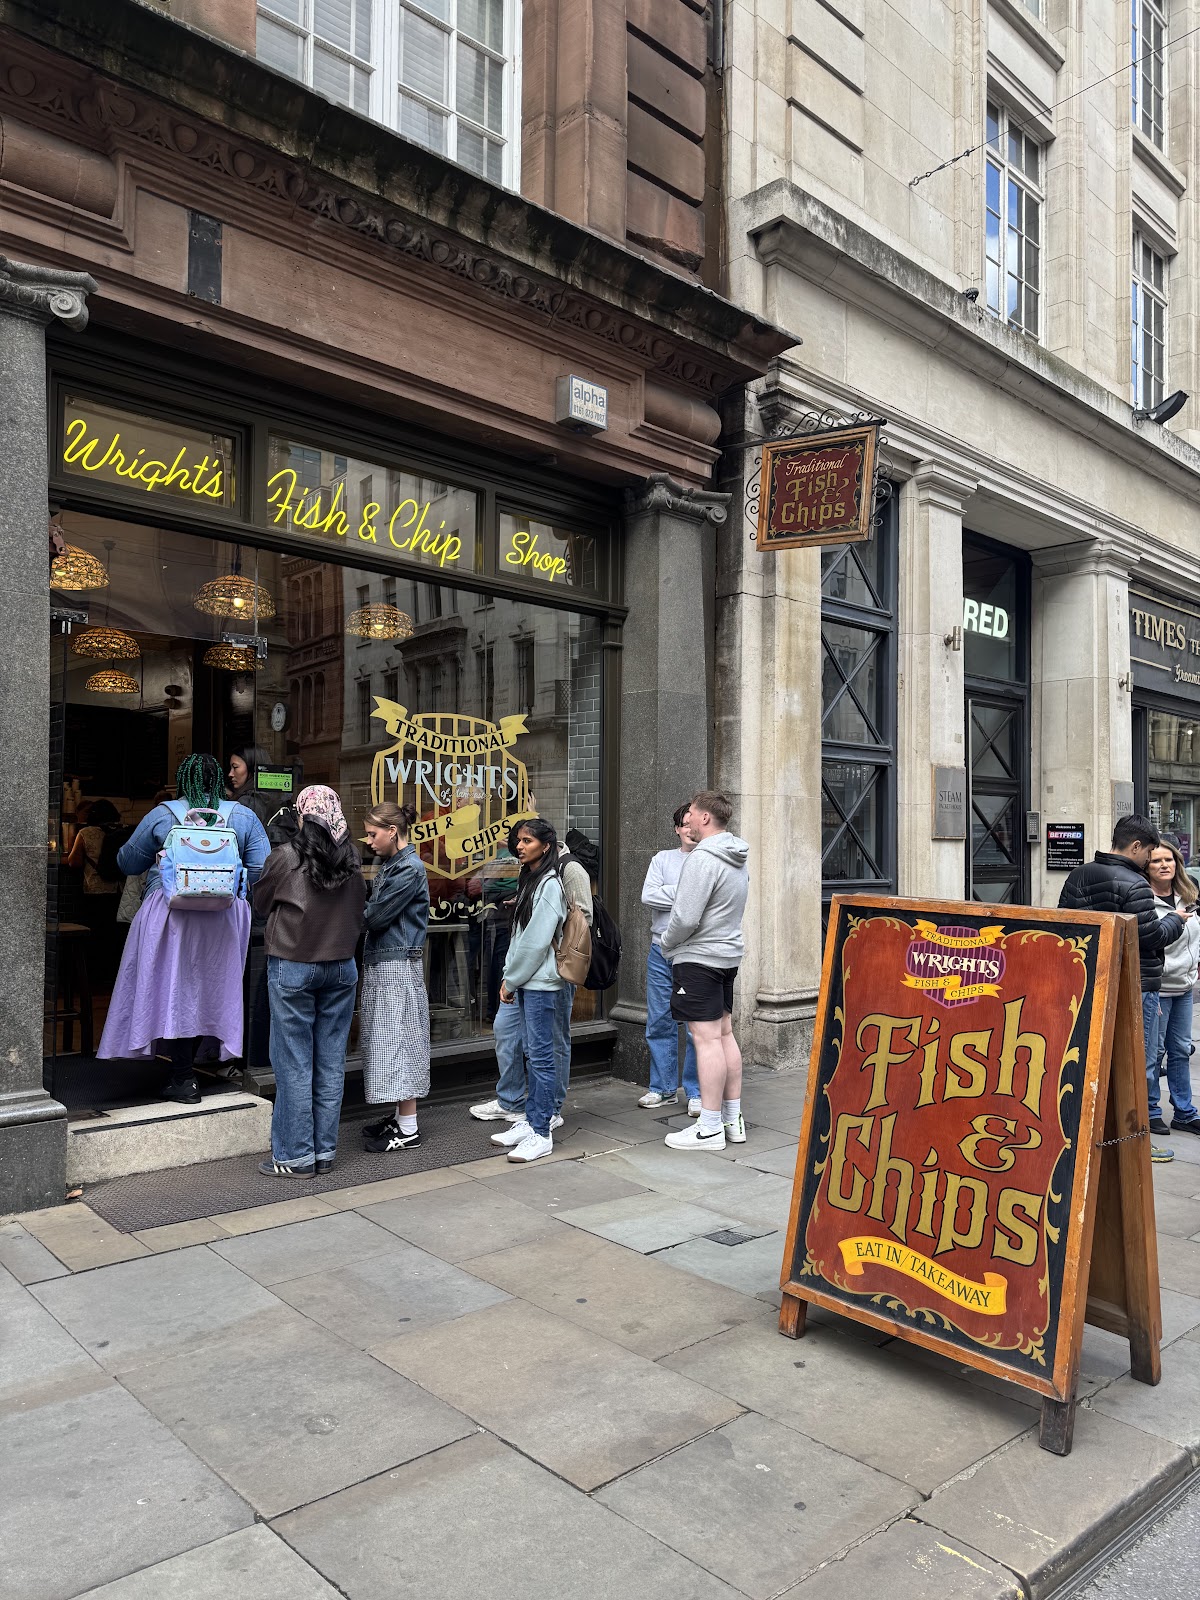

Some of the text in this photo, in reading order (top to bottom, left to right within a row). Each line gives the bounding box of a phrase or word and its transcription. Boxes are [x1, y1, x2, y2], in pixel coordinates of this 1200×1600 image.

[574, 384, 605, 408] alpha
[785, 453, 850, 476] Traditional
[785, 469, 838, 501] Fish
[820, 477, 850, 504] &
[63, 419, 224, 498] Wright's
[267, 468, 350, 536] Fish
[358, 502, 380, 543] &
[388, 498, 462, 567] Chip
[505, 531, 568, 582] Shop
[781, 499, 846, 527] Chips
[1131, 607, 1186, 652] TIMES
[395, 718, 510, 753] TRADITIONAL
[384, 757, 518, 807] WRIGHTS
[938, 790, 962, 803] STEAM
[1116, 801, 1132, 812] STEAM
[411, 821, 439, 841] SH
[461, 819, 512, 853] CHIPS
[1049, 831, 1082, 839] BETFRED
[926, 931, 990, 946] TRADITIONAL
[912, 951, 1000, 978] WRIGHTS
[914, 978, 950, 987] FISH &
[951, 986, 984, 998] CHIPS
[855, 997, 1047, 1121] Fish
[958, 1113, 1042, 1172] &
[827, 1111, 1046, 1267] Chips
[855, 1242, 884, 1257] EAT
